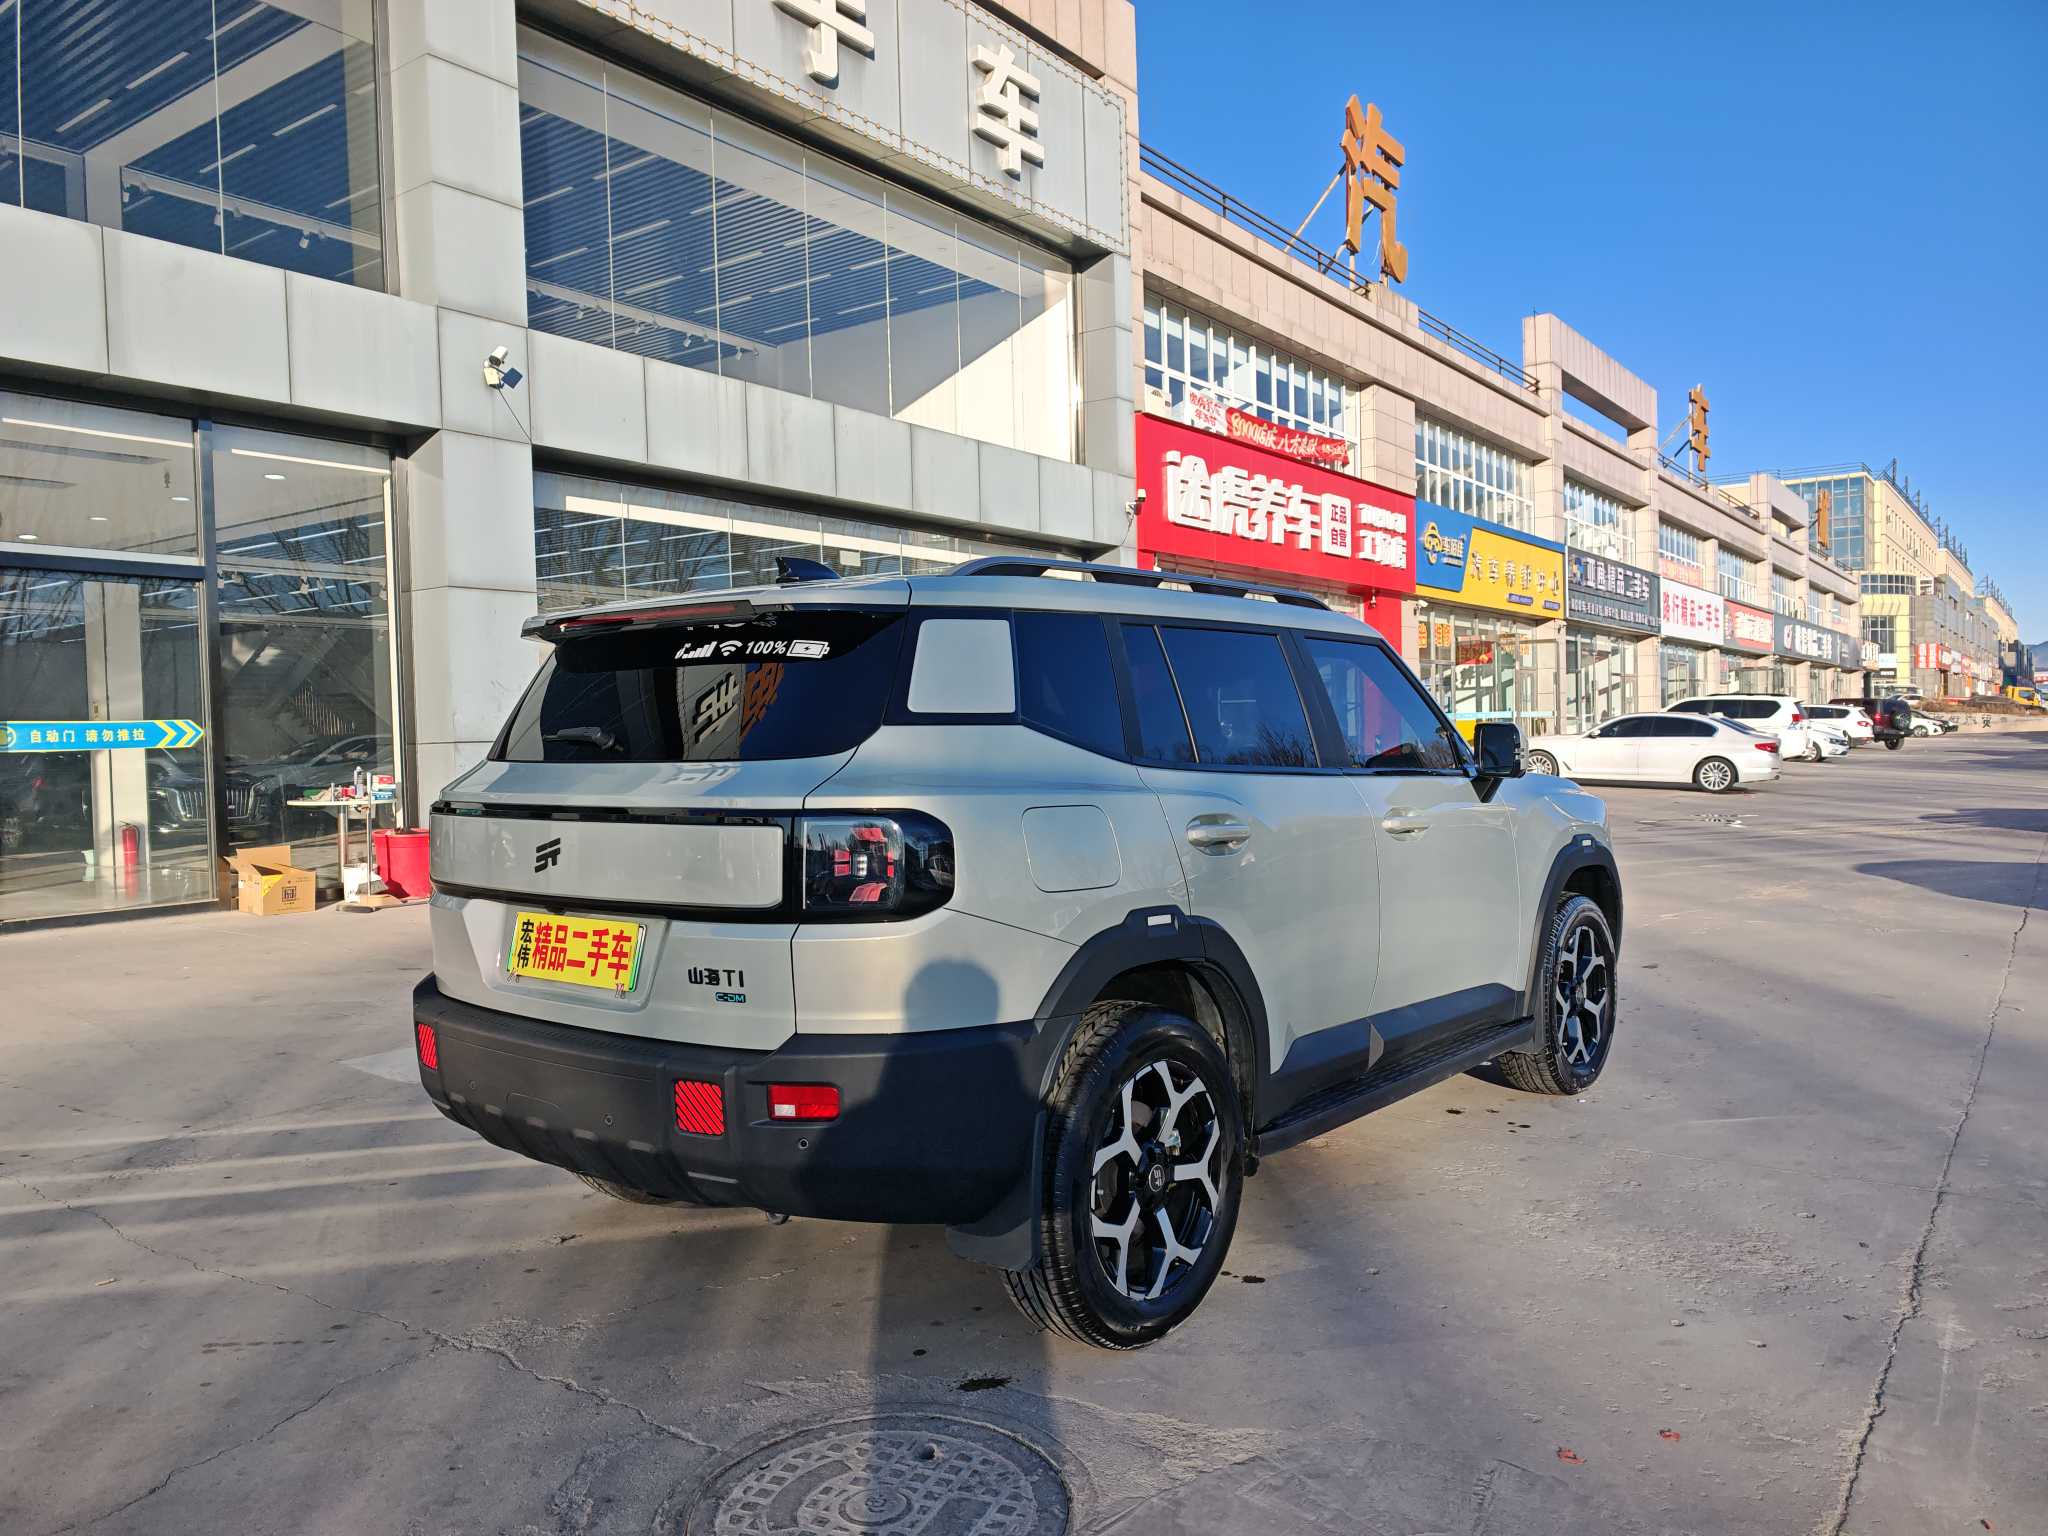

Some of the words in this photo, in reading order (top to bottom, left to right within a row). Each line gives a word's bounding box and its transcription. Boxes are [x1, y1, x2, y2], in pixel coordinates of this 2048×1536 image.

[1342, 94, 1408, 284] 汽
[1165, 450, 1323, 550] 途虎养车
[1330, 503, 1347, 524] 正品
[745, 640, 788, 655] 100%
[29, 728, 76, 743] 自动门
[86, 727, 146, 743] 请勿推拉
[517, 918, 535, 969] 宏伟
[532, 920, 633, 980] 精品二手车
[716, 993, 746, 1003] C-DM
